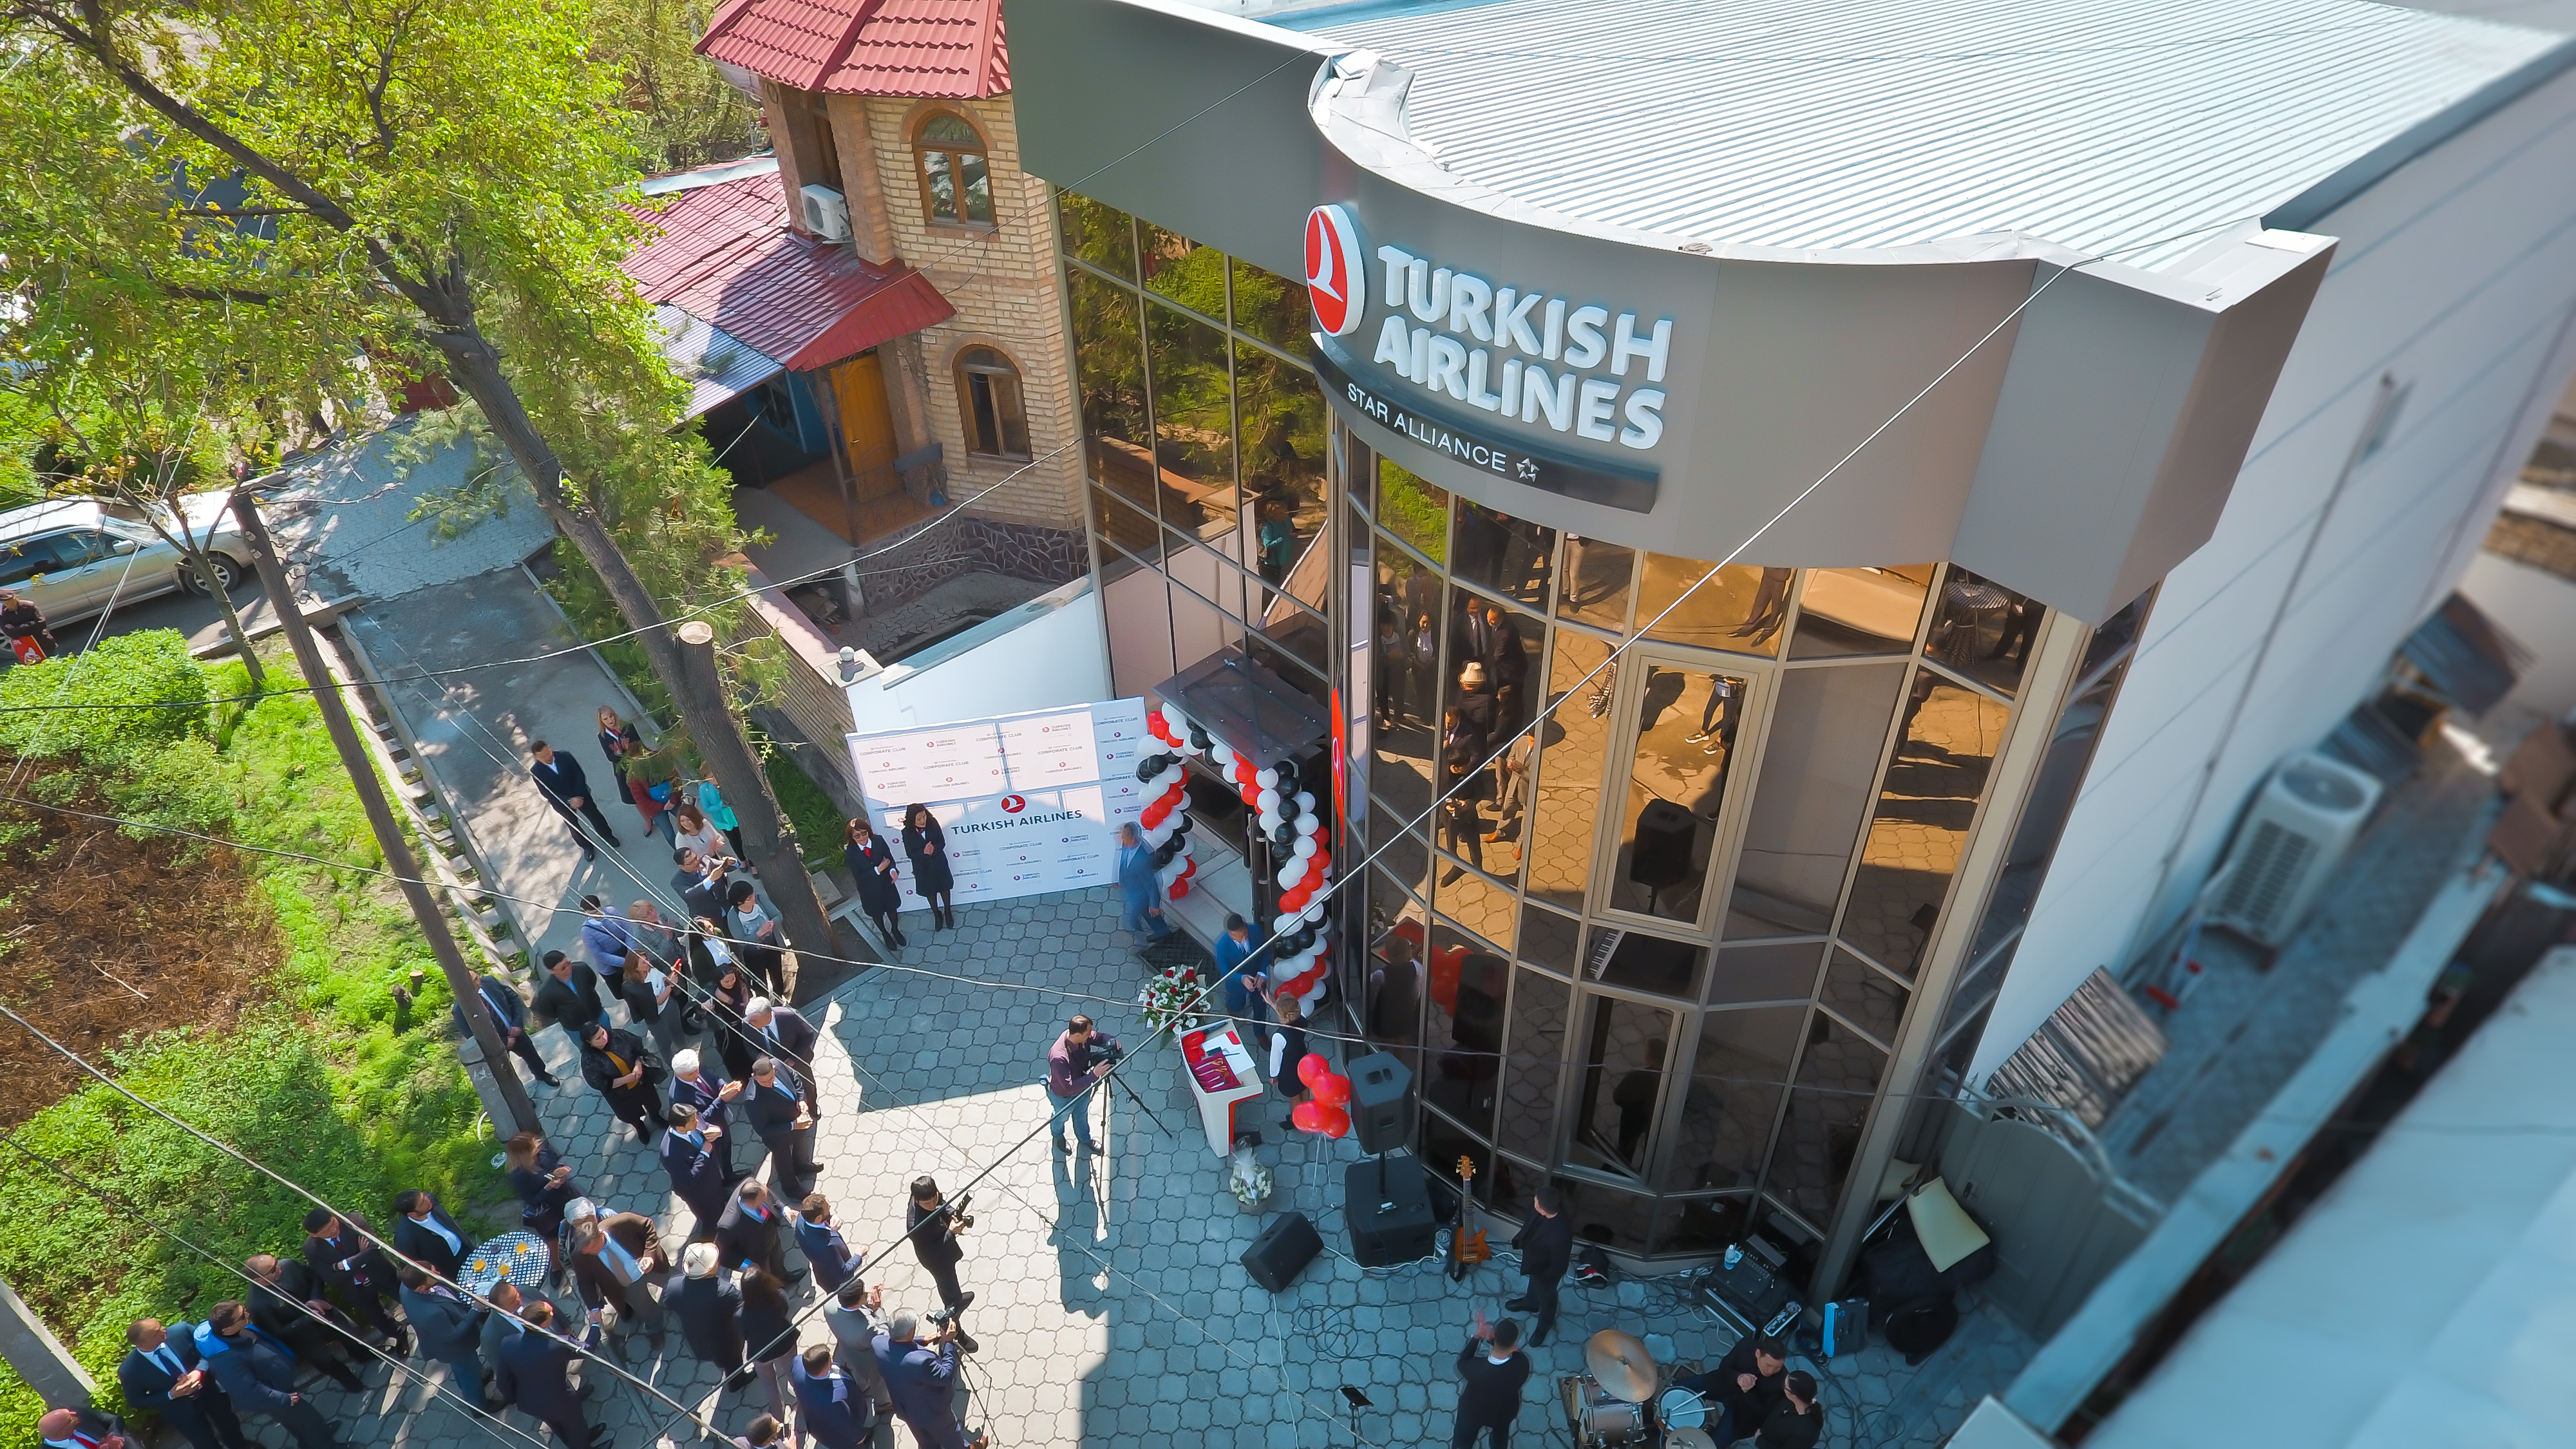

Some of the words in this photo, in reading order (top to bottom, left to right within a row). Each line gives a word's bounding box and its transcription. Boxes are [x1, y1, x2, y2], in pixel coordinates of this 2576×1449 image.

[1378, 245, 1672, 382] TURKISH
[1347, 383, 1388, 423] STAR
[1394, 413, 1507, 472] ALLIANCE
[1374, 315, 1666, 450] AIRLINES
[951, 819, 1014, 835] TURKISH
[1019, 810, 1083, 826] AIRLINES
